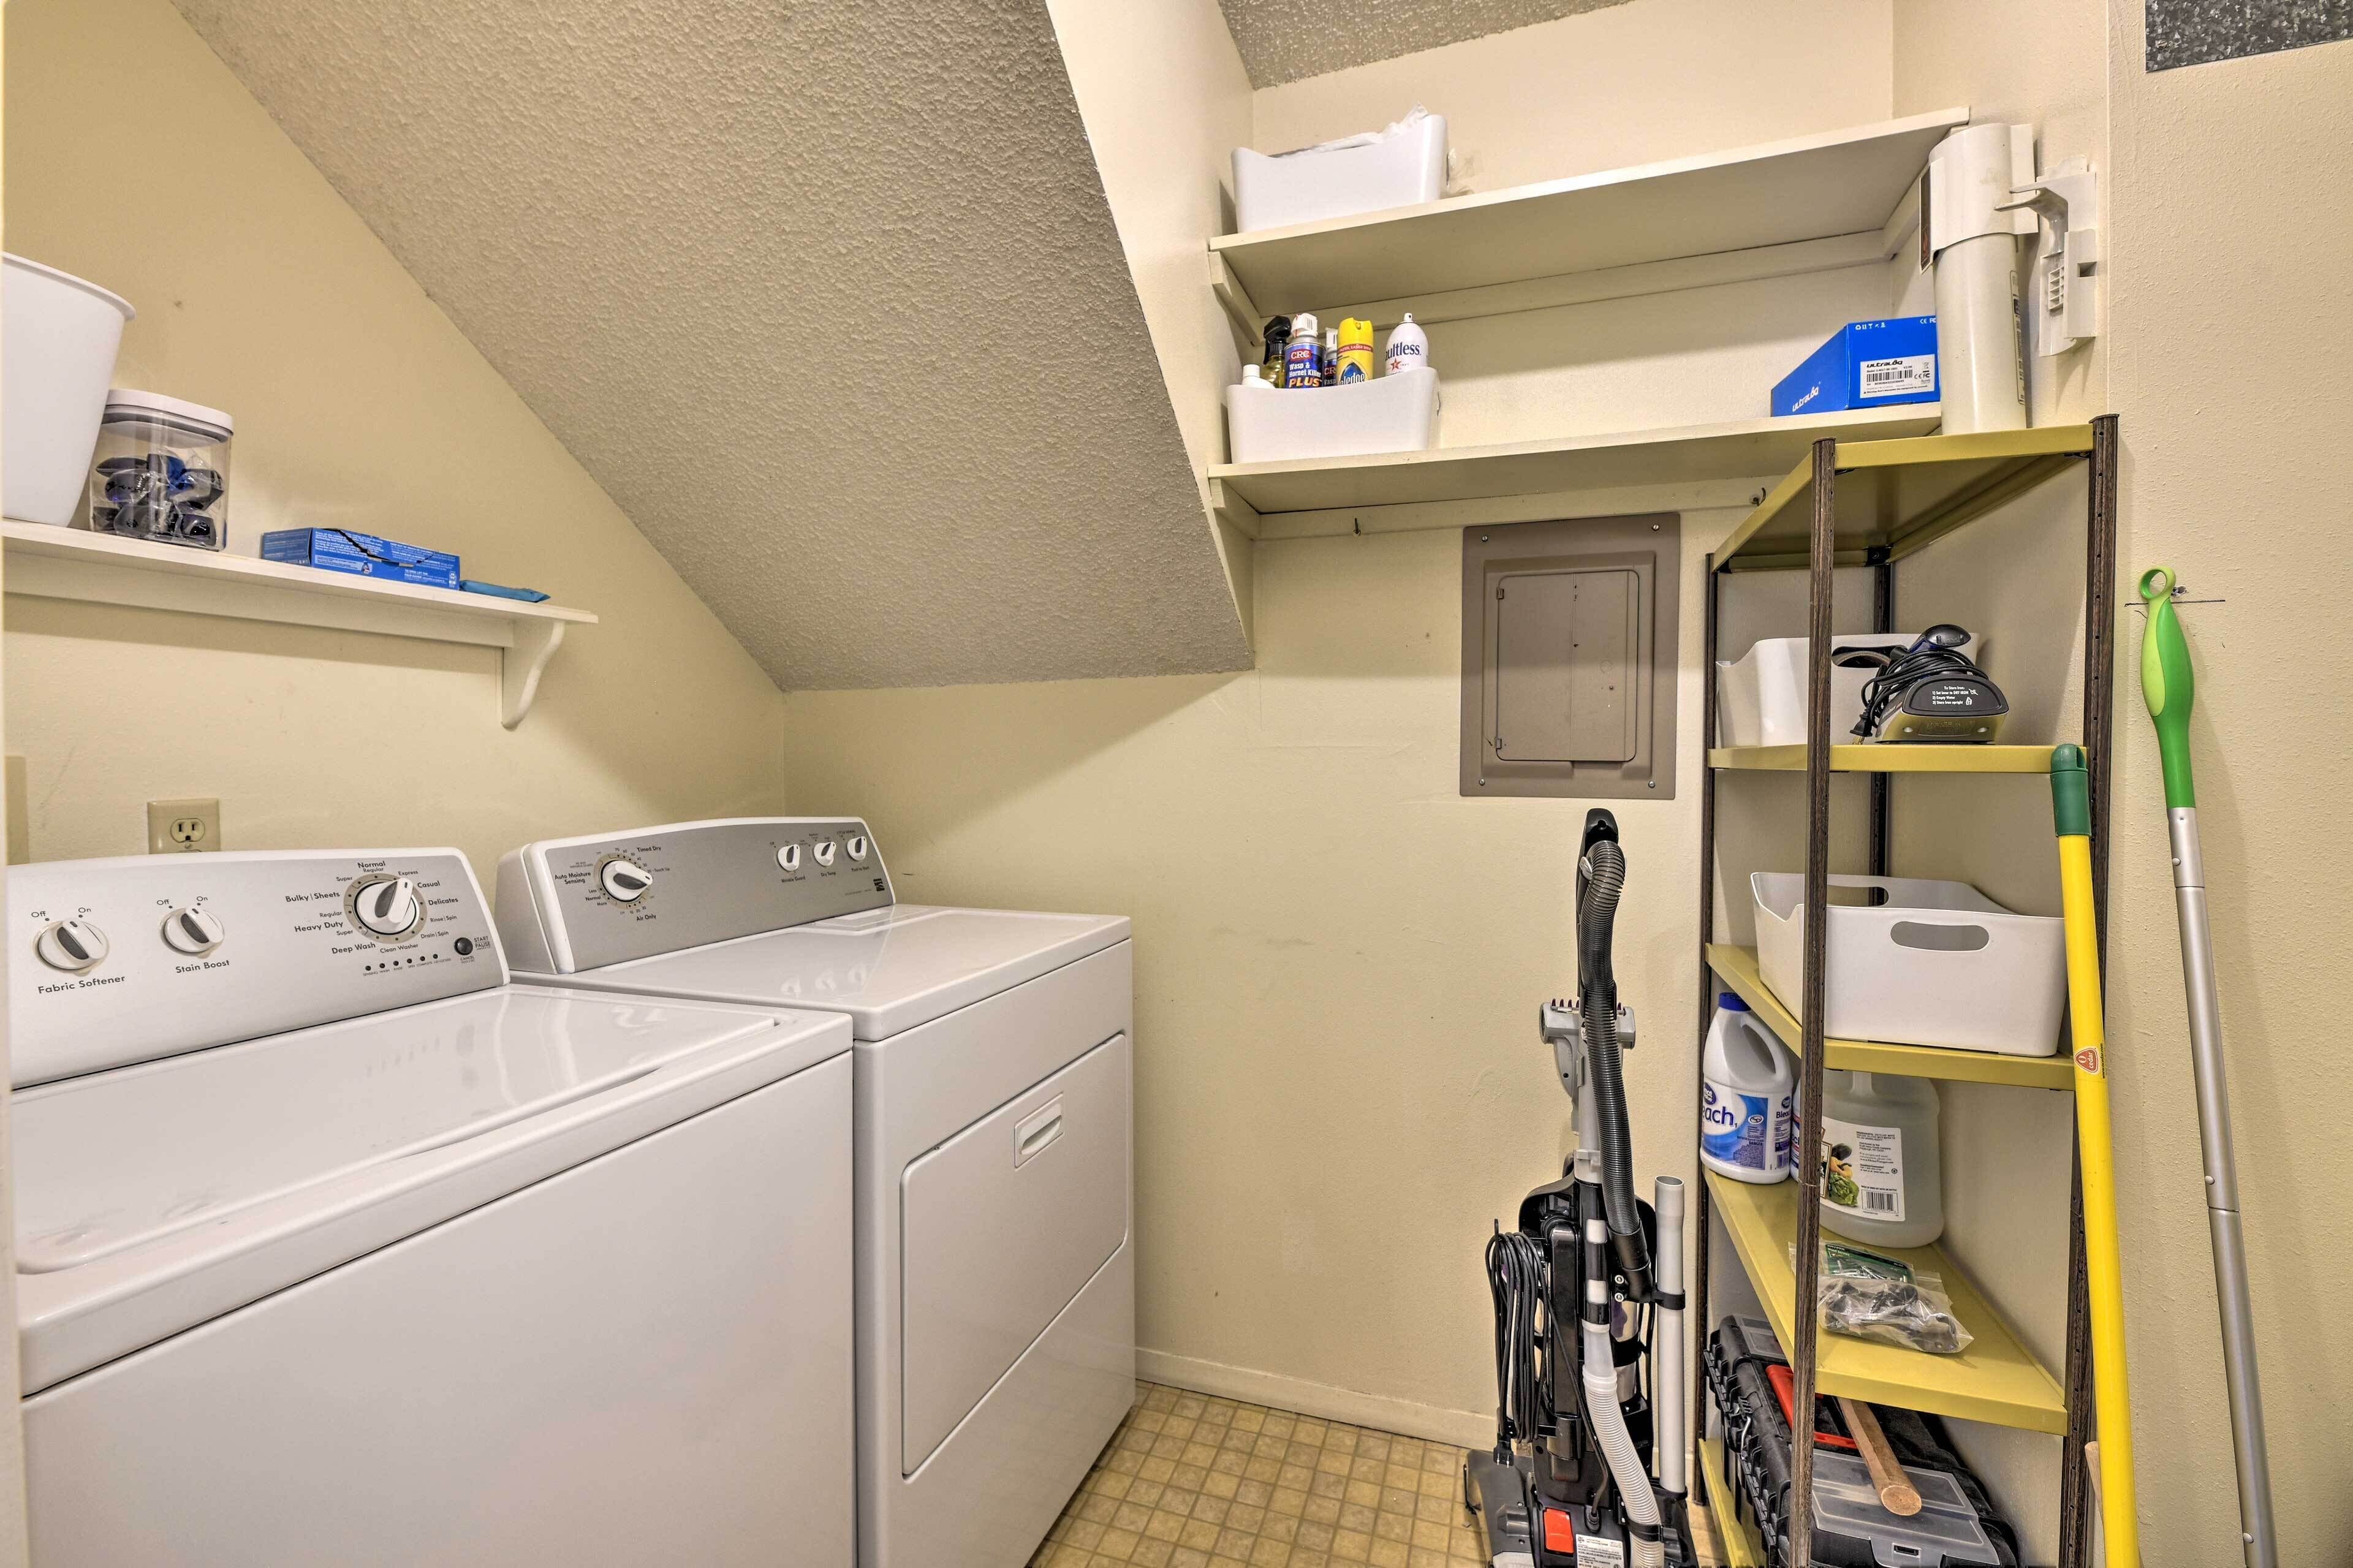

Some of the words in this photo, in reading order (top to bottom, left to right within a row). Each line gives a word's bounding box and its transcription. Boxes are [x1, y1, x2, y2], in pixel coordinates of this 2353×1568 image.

[1290, 350, 1309, 359] CRC
[1289, 377, 1320, 388] PLUS
[428, 897, 458, 906] Delicates
[175, 964, 200, 974] Stain
[203, 960, 230, 969] Boost
[38, 982, 75, 994] Fabric
[78, 975, 126, 988] Softener
